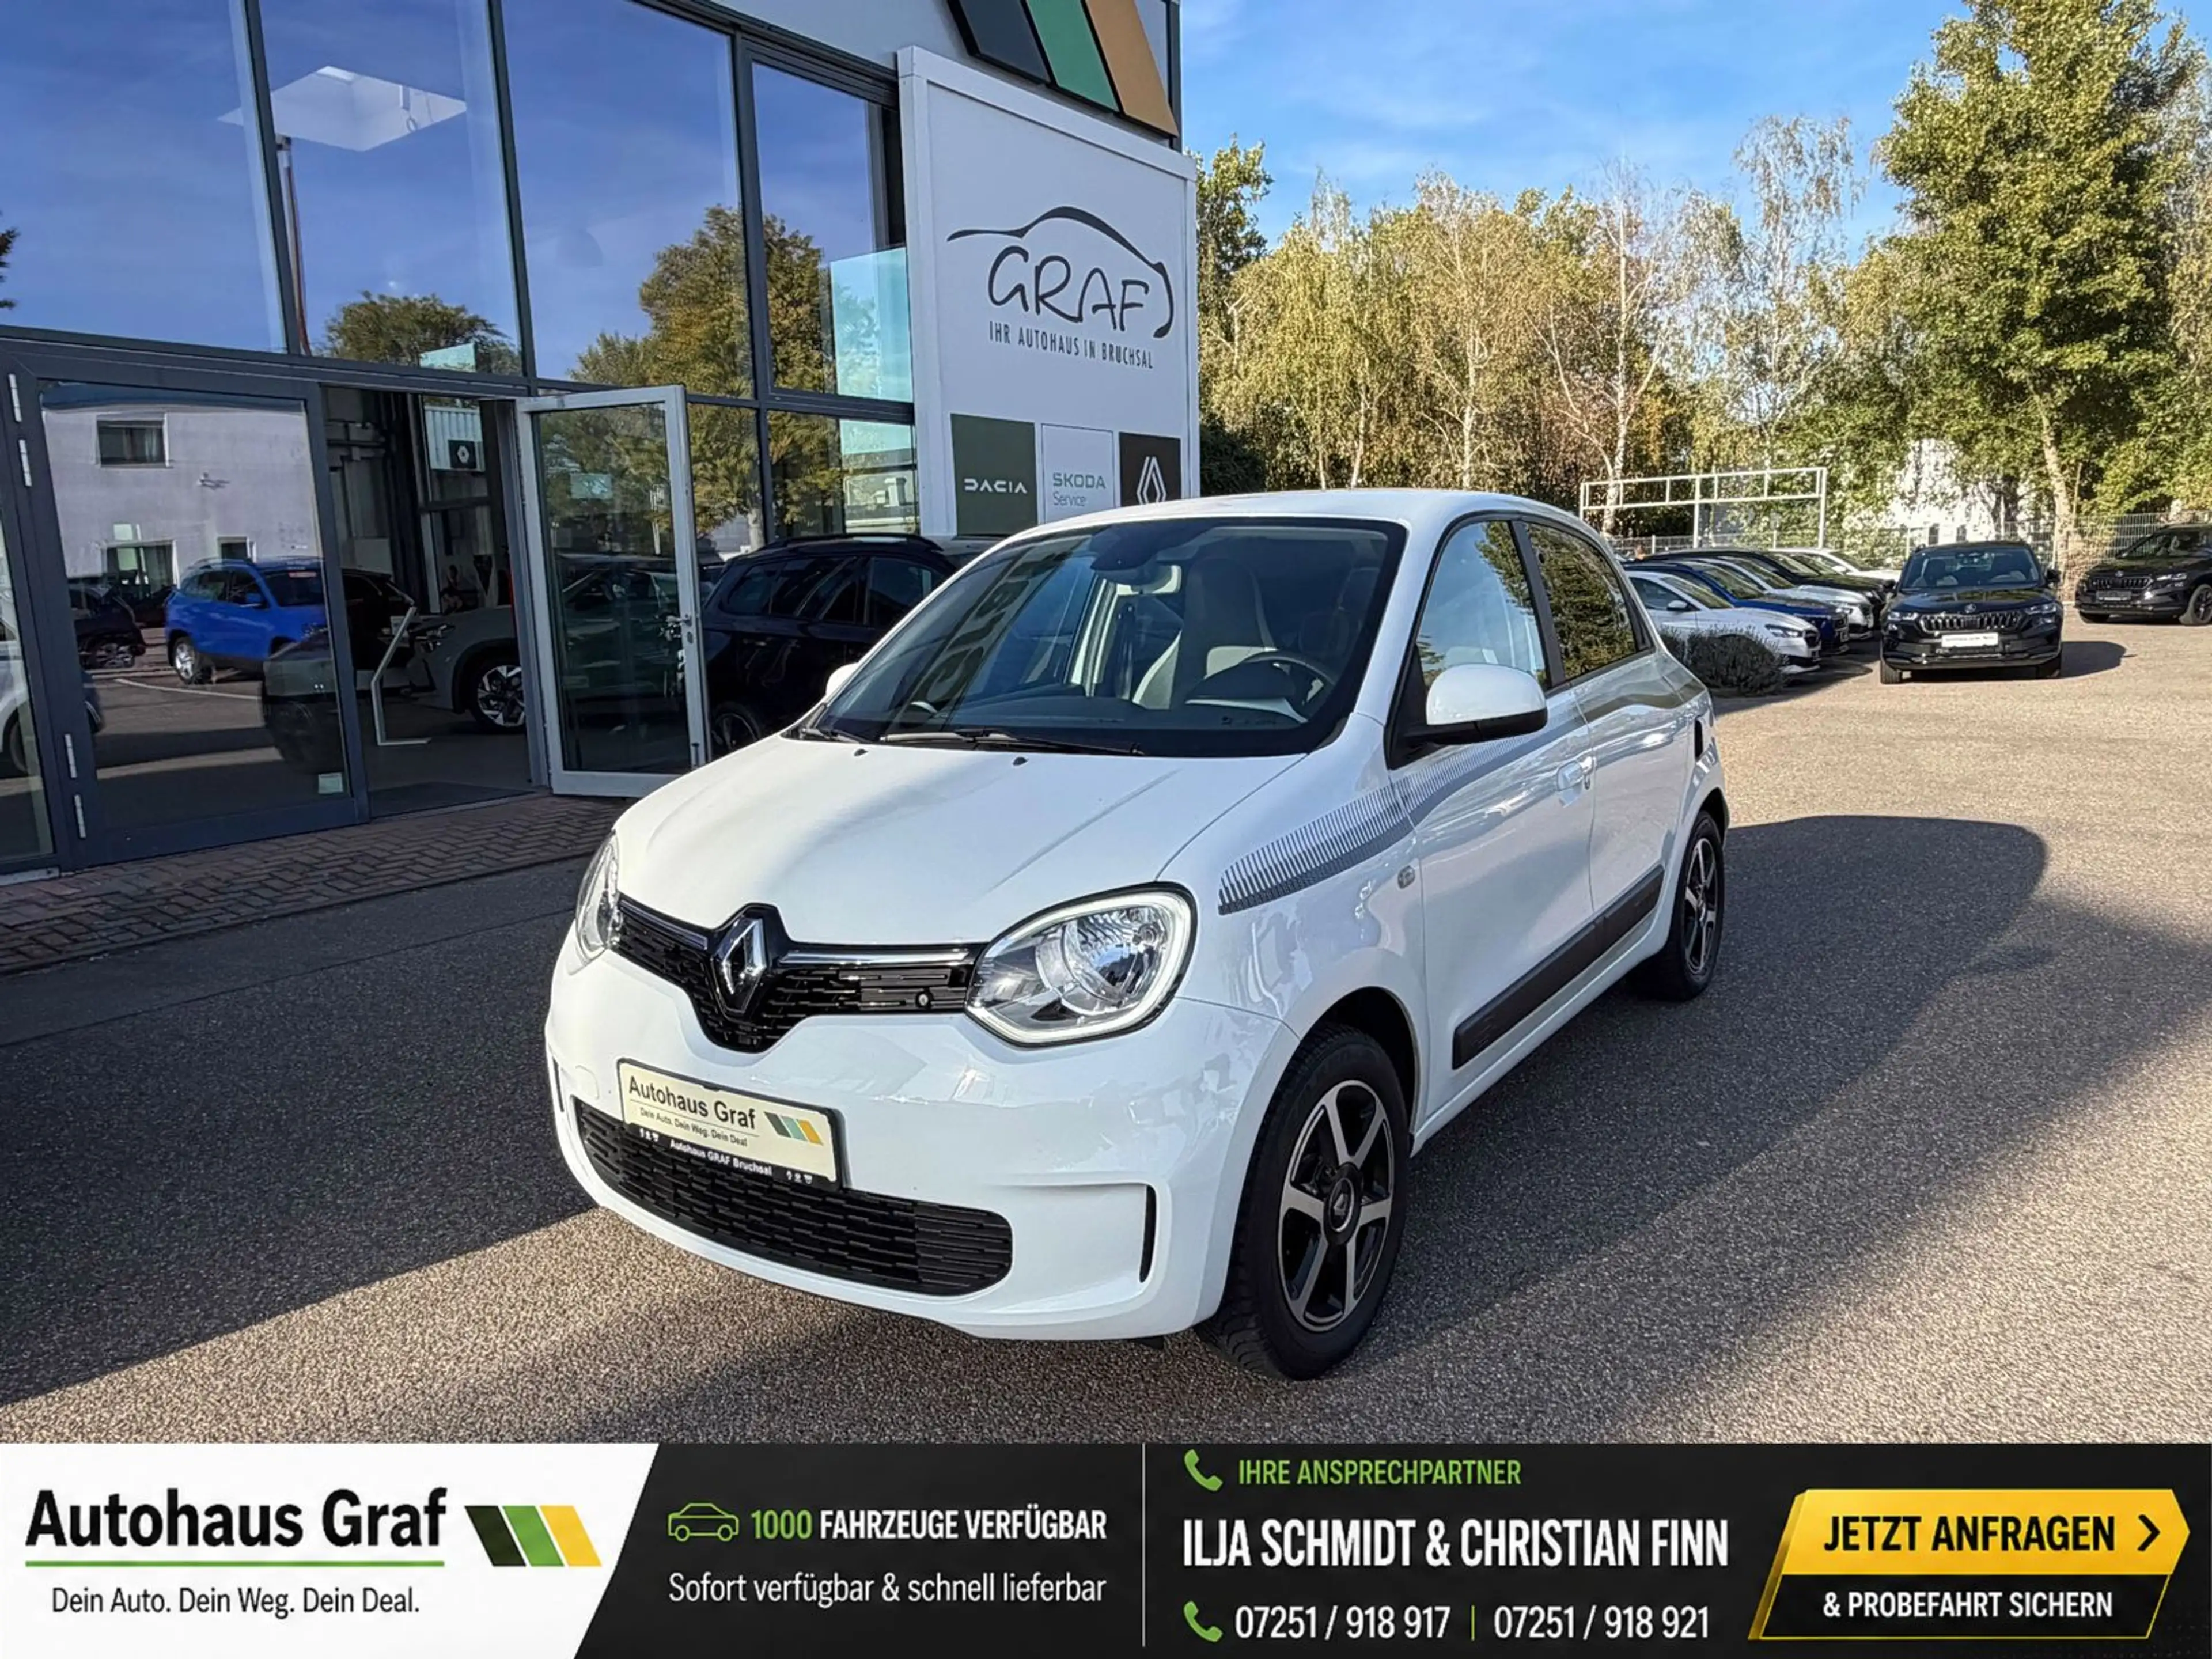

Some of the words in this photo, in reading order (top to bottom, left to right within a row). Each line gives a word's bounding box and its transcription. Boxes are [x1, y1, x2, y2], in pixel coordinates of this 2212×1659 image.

[988, 245, 1150, 332] GRAF
[990, 320, 1011, 344] IHR
[1018, 327, 1080, 357] AUTOHAUS
[1083, 339, 1096, 359] IN
[1101, 343, 1154, 369] BRUCHSAL
[963, 478, 1028, 494] DACIA
[1052, 491, 1088, 507] Service
[628, 1075, 709, 1118] Autohaus
[714, 1101, 756, 1130] Graf
[640, 1107, 654, 1120] Dein
[675, 1119, 690, 1131] Dein
[711, 1129, 728, 1142] Dein
[670, 1139, 706, 1158] Autohaus
[707, 1151, 731, 1165] GRAF
[732, 1157, 772, 1176] Bruchsal
